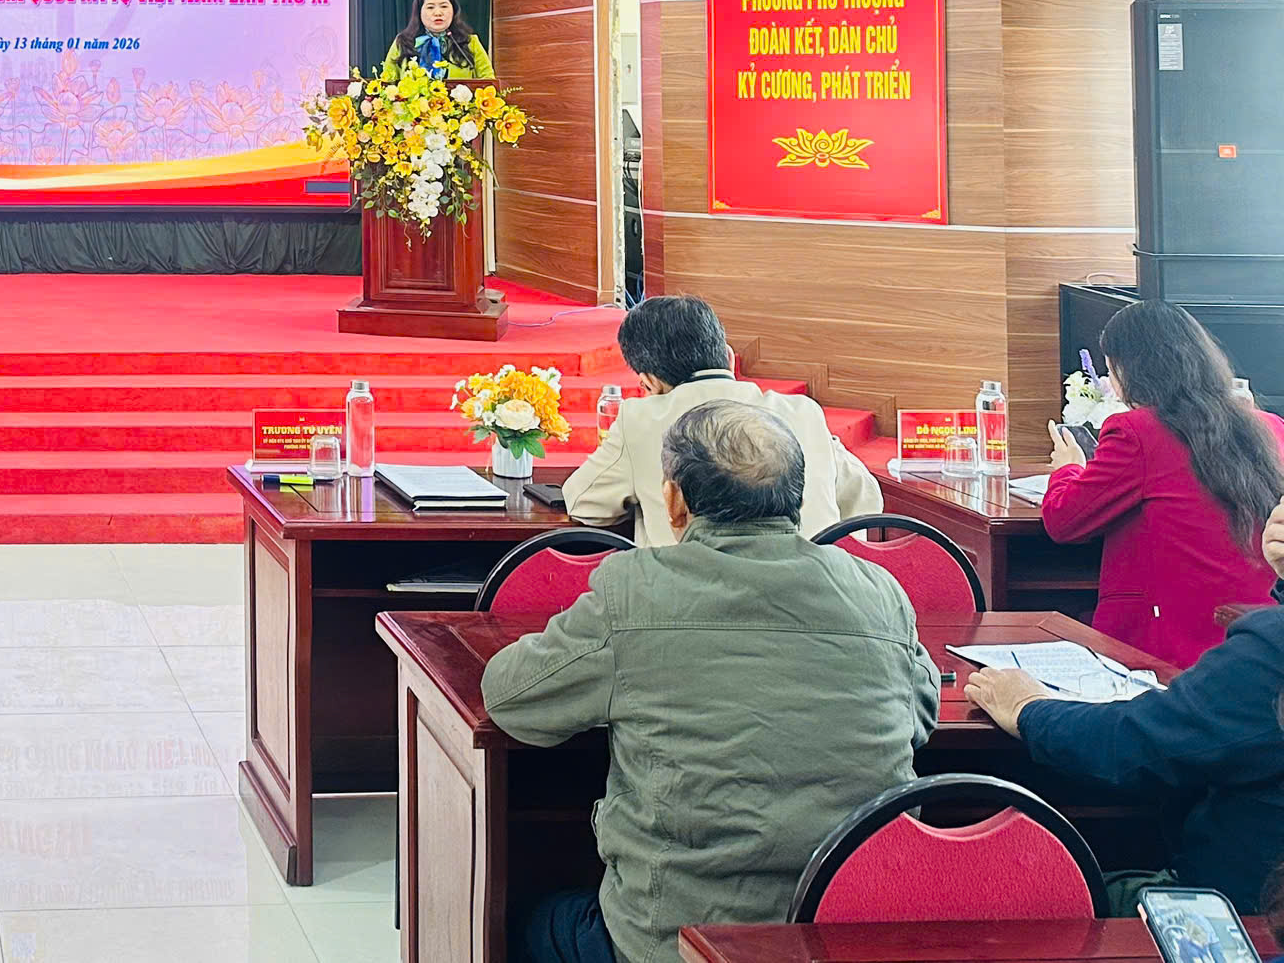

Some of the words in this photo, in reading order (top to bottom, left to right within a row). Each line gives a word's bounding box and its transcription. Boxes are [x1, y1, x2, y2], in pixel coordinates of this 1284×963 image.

[14, 37, 27, 49] 13
[30, 37, 63, 52] tháng
[67, 38, 79, 49] 01
[83, 39, 109, 49] năm
[112, 38, 140, 49] 2026
[749, 22, 790, 56] ĐOÀN
[794, 17, 825, 59] KẾT,
[829, 20, 861, 55] DÂN
[866, 15, 898, 54] CHỦ
[761, 71, 817, 104] CƯƠNG,
[821, 64, 860, 100] PHÁT
[865, 60, 911, 100] TRIỂN
